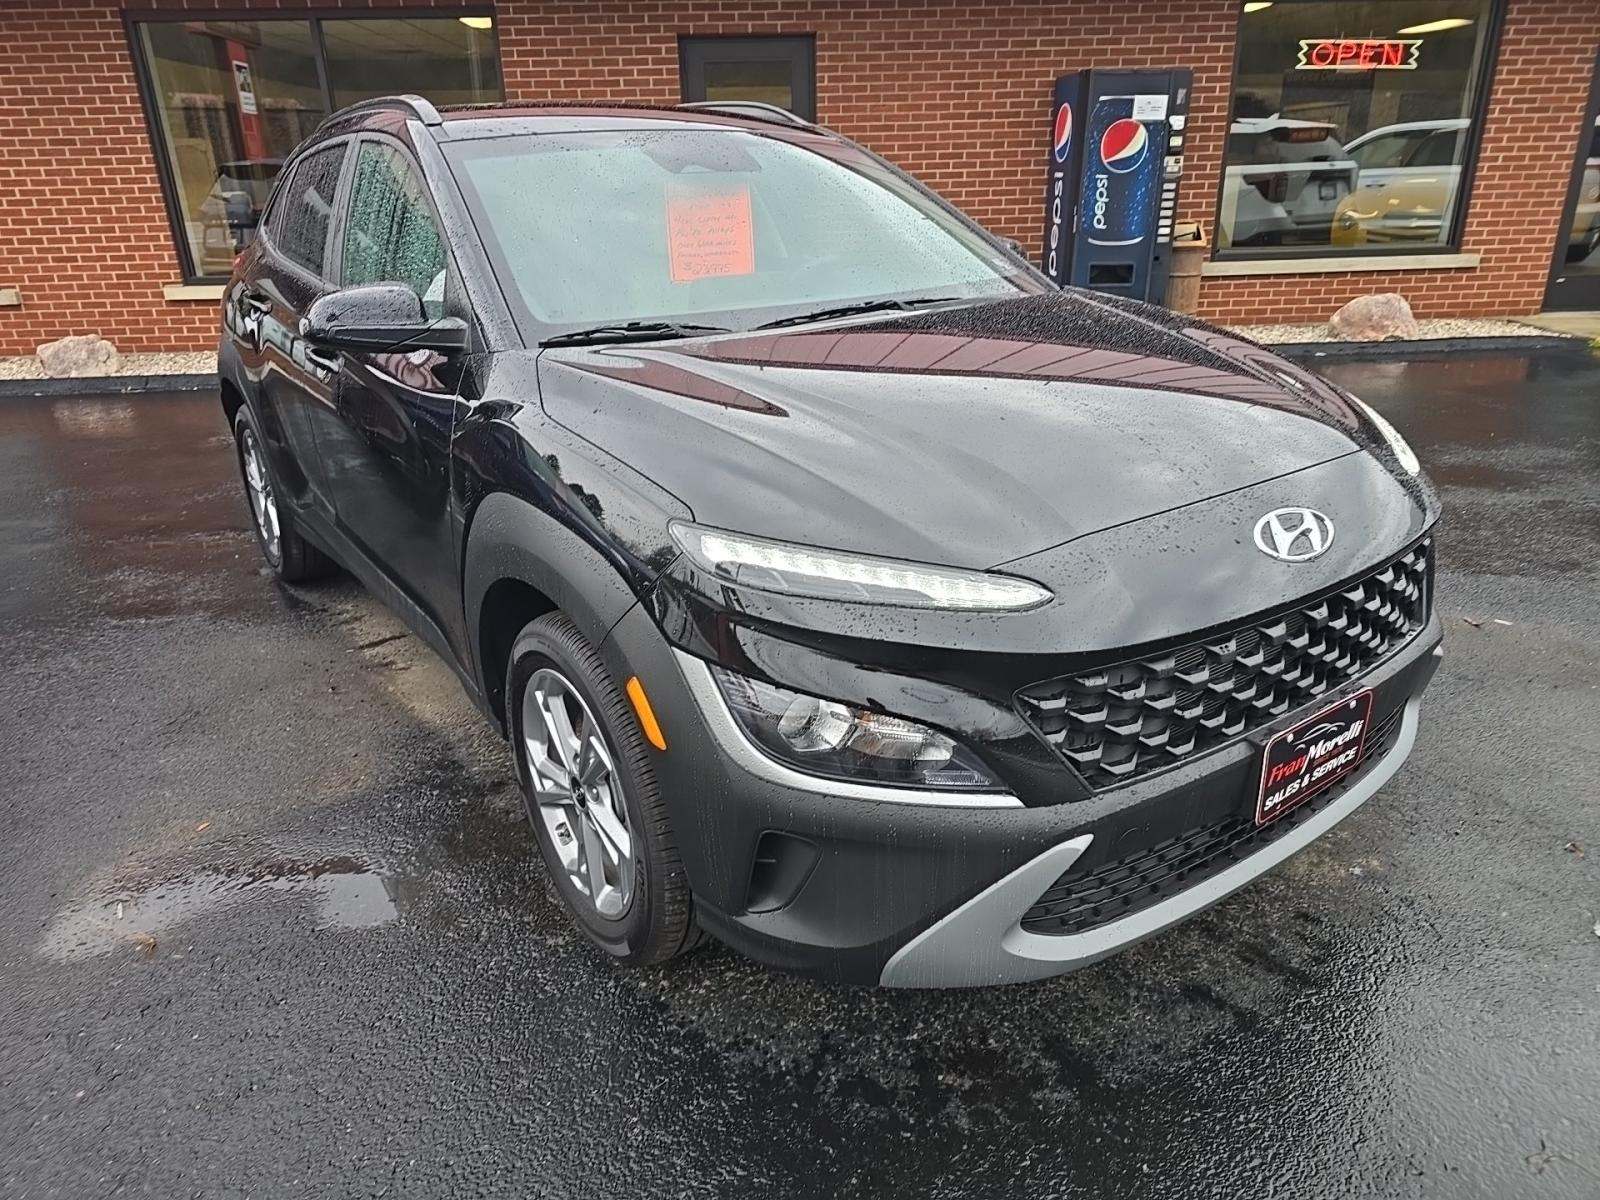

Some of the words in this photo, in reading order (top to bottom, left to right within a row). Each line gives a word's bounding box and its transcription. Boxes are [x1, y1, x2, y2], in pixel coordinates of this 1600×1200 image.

[1312, 42, 1404, 67] OPEN
[1049, 171, 1064, 277] pepsi
[1093, 173, 1110, 230] pepsi
[1263, 778, 1302, 812] SALES
[1300, 773, 1311, 789] &
[1310, 745, 1359, 782] SERVICE
[1267, 754, 1307, 788] Fran
